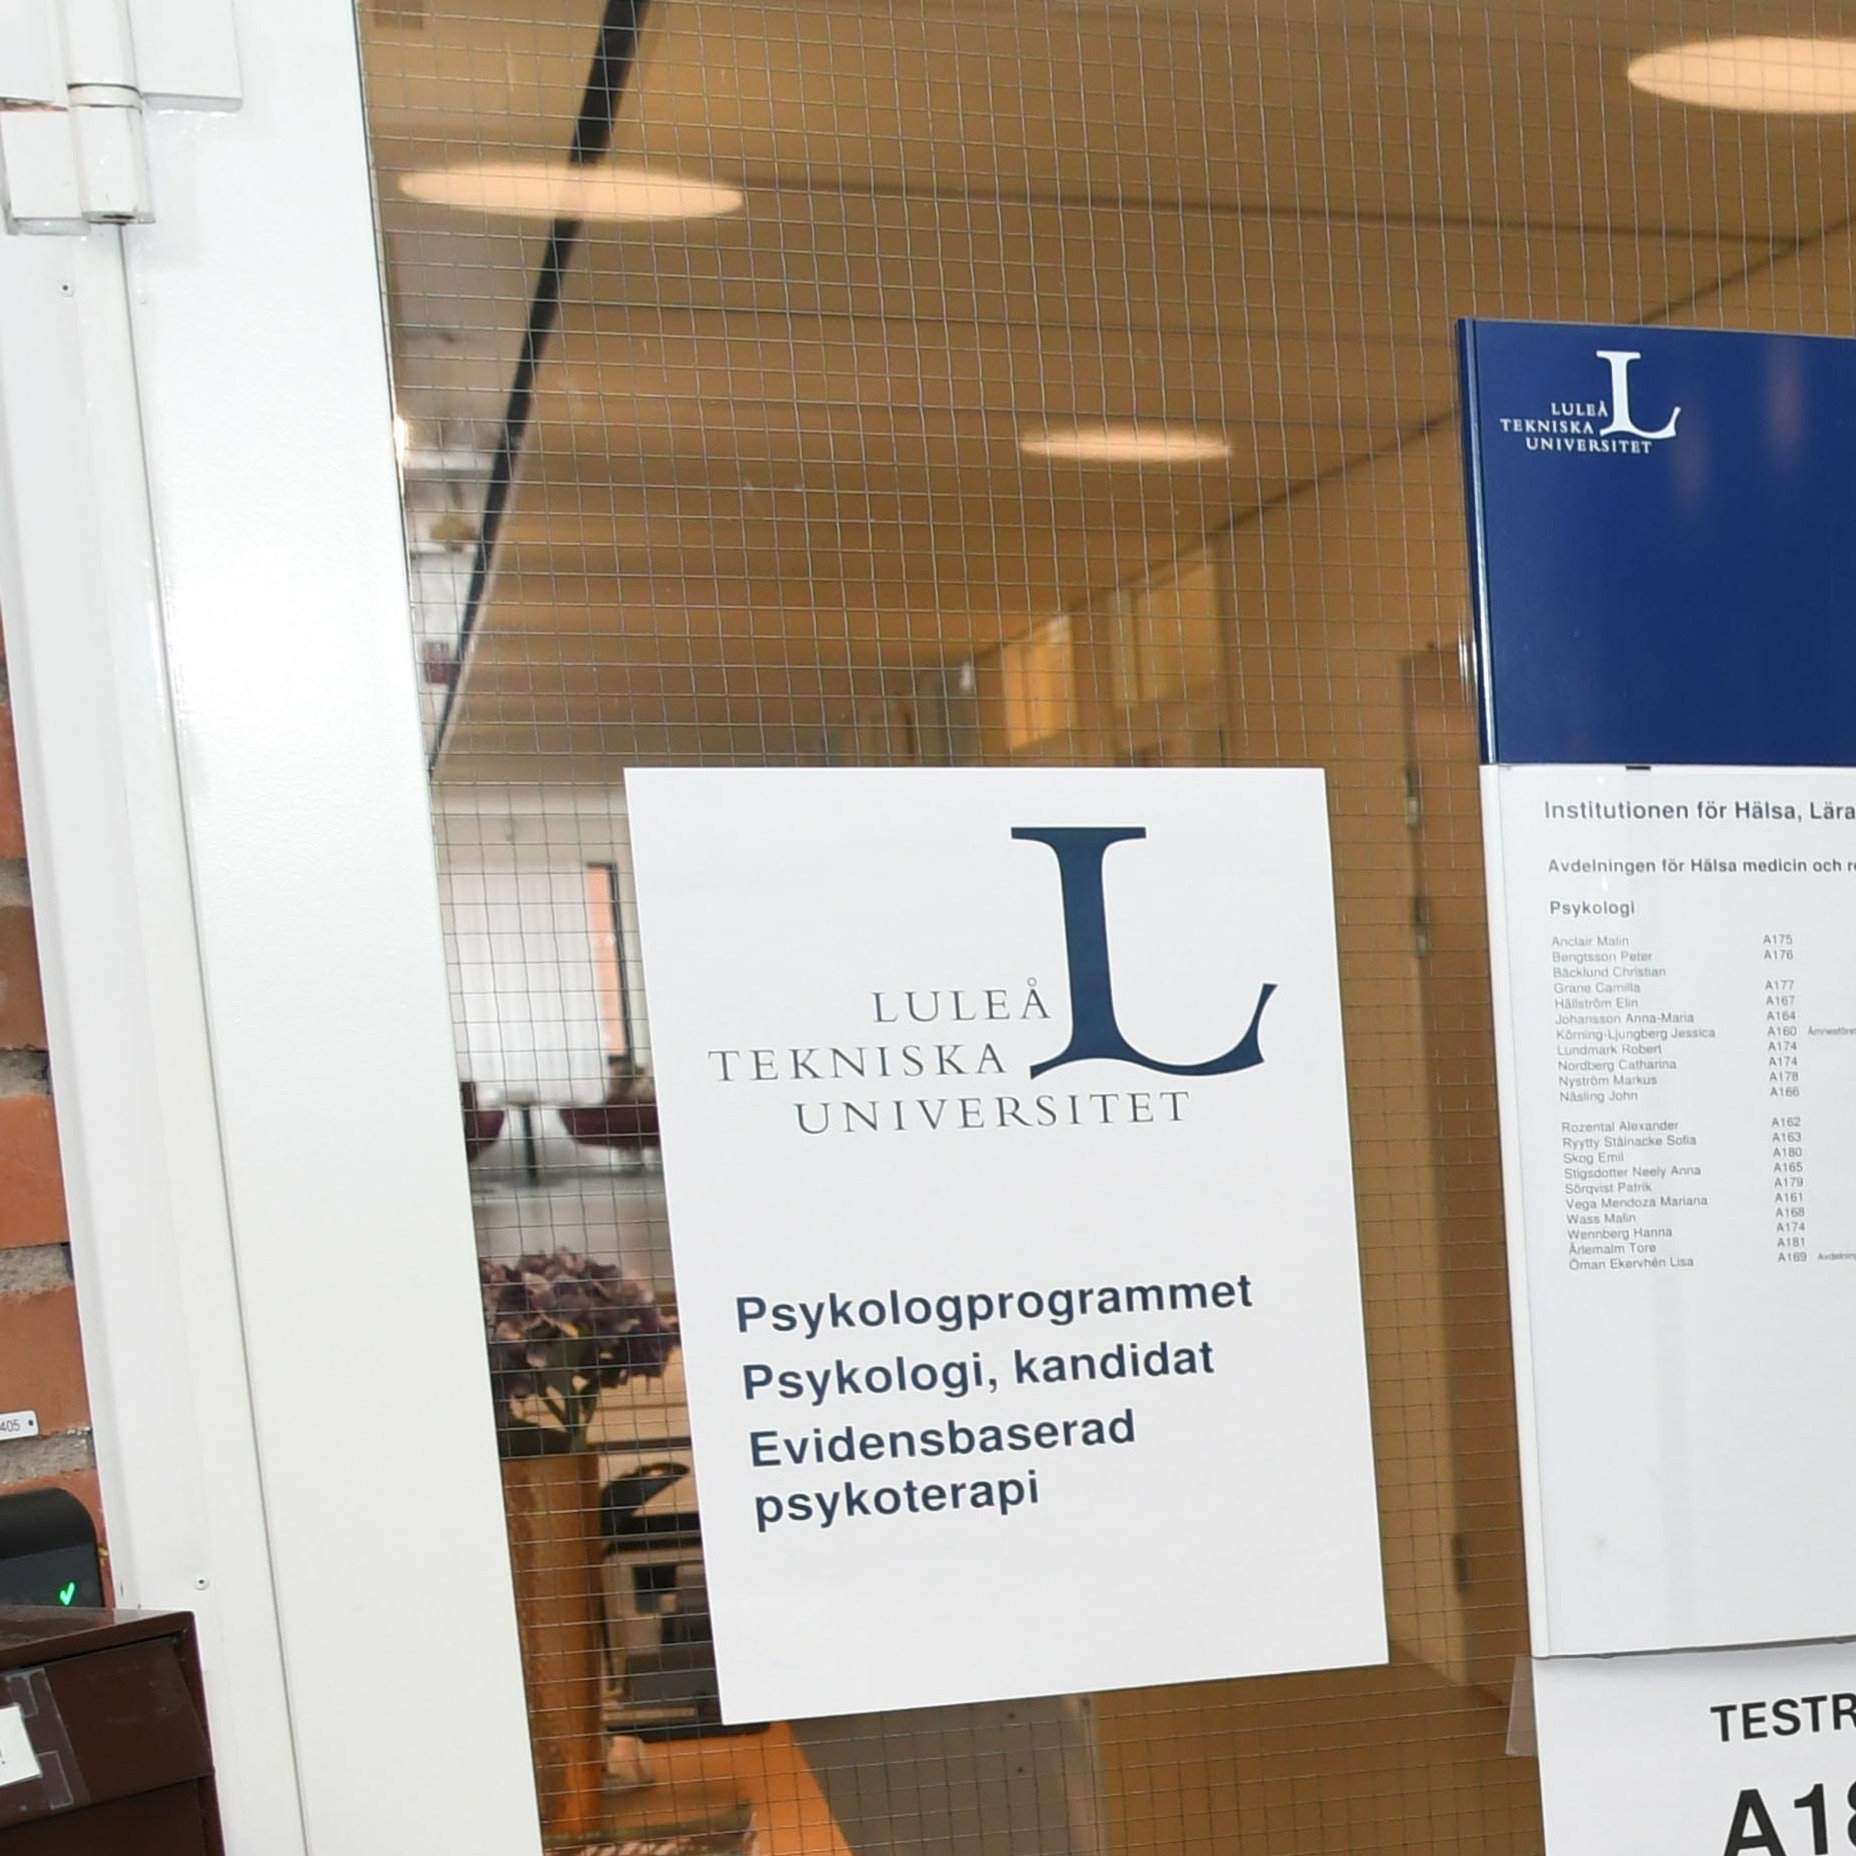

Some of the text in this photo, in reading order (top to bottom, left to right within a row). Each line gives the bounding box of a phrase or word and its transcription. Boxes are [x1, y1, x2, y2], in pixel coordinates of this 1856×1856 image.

[1551, 400, 1609, 417] LULEÅ
[1500, 418, 1594, 435] TEKNISKA
[1525, 437, 1652, 454] UNIVERSITET
[1544, 800, 1689, 819] Institutionen
[1698, 800, 1727, 819] för
[1735, 800, 1802, 823] Hälsa,
[1548, 858, 1656, 876] Avdelningen
[1662, 858, 1685, 872] för
[1690, 858, 1737, 872] Hälsa
[1742, 858, 1807, 872] medicin
[1812, 858, 1842, 872] och
[1549, 900, 1635, 917] Psykologi
[1551, 934, 1793, 947] Anclair Malin A175
[1552, 951, 1616, 964] Bengtsson
[1621, 950, 1653, 962] Peter
[1612, 966, 1666, 977] Christian
[1595, 982, 1641, 993] Camilla
[1765, 980, 1795, 991] A177
[873, 977, 1051, 1023] LULEÅ
[1616, 997, 1639, 1008] Elin
[1766, 995, 1796, 1006] A167
[1555, 1011, 1796, 1025] Johansson Anna-Maria A164
[1671, 1027, 1716, 1039] Jessica
[1557, 1041, 1798, 1056] Lundmark Robert A174
[708, 1043, 1006, 1082] TEKNISKA
[1558, 1060, 1615, 1073] Nordberg
[1768, 1056, 1798, 1067] A174
[1559, 1075, 1609, 1089] Nyström
[1613, 1074, 1658, 1085] Markus
[1608, 1091, 1638, 1101] John
[793, 1091, 1189, 1134] UNIVERSITET
[1561, 1117, 1802, 1133] Rozental Alexander A162
[1666, 1135, 1697, 1146] Sofia
[1772, 1132, 1802, 1142] A163
[1563, 1152, 1594, 1165] Skog
[1598, 1152, 1624, 1163] Emil
[1564, 1162, 1803, 1180] Stigsdotter Neely Anna A165
[1617, 1182, 1652, 1193] Patrik
[1566, 1192, 1803, 1211] Vega Mendoza Mariana A161
[1566, 1214, 1600, 1225] Wass
[1604, 1213, 1636, 1224] Malin
[1567, 1222, 1806, 1241] Wennberg Hanna A174
[1629, 1243, 1657, 1253] Tore
[1569, 1257, 1606, 1270] Öman
[1670, 1256, 1695, 1267] Lisa
[736, 1275, 1254, 1340] Psykologprogrammet
[742, 1341, 1215, 1406] Psykologi, kandidat
[749, 1408, 1136, 1467] Evidensbaserad
[755, 1469, 1039, 1532] psykoterapi
